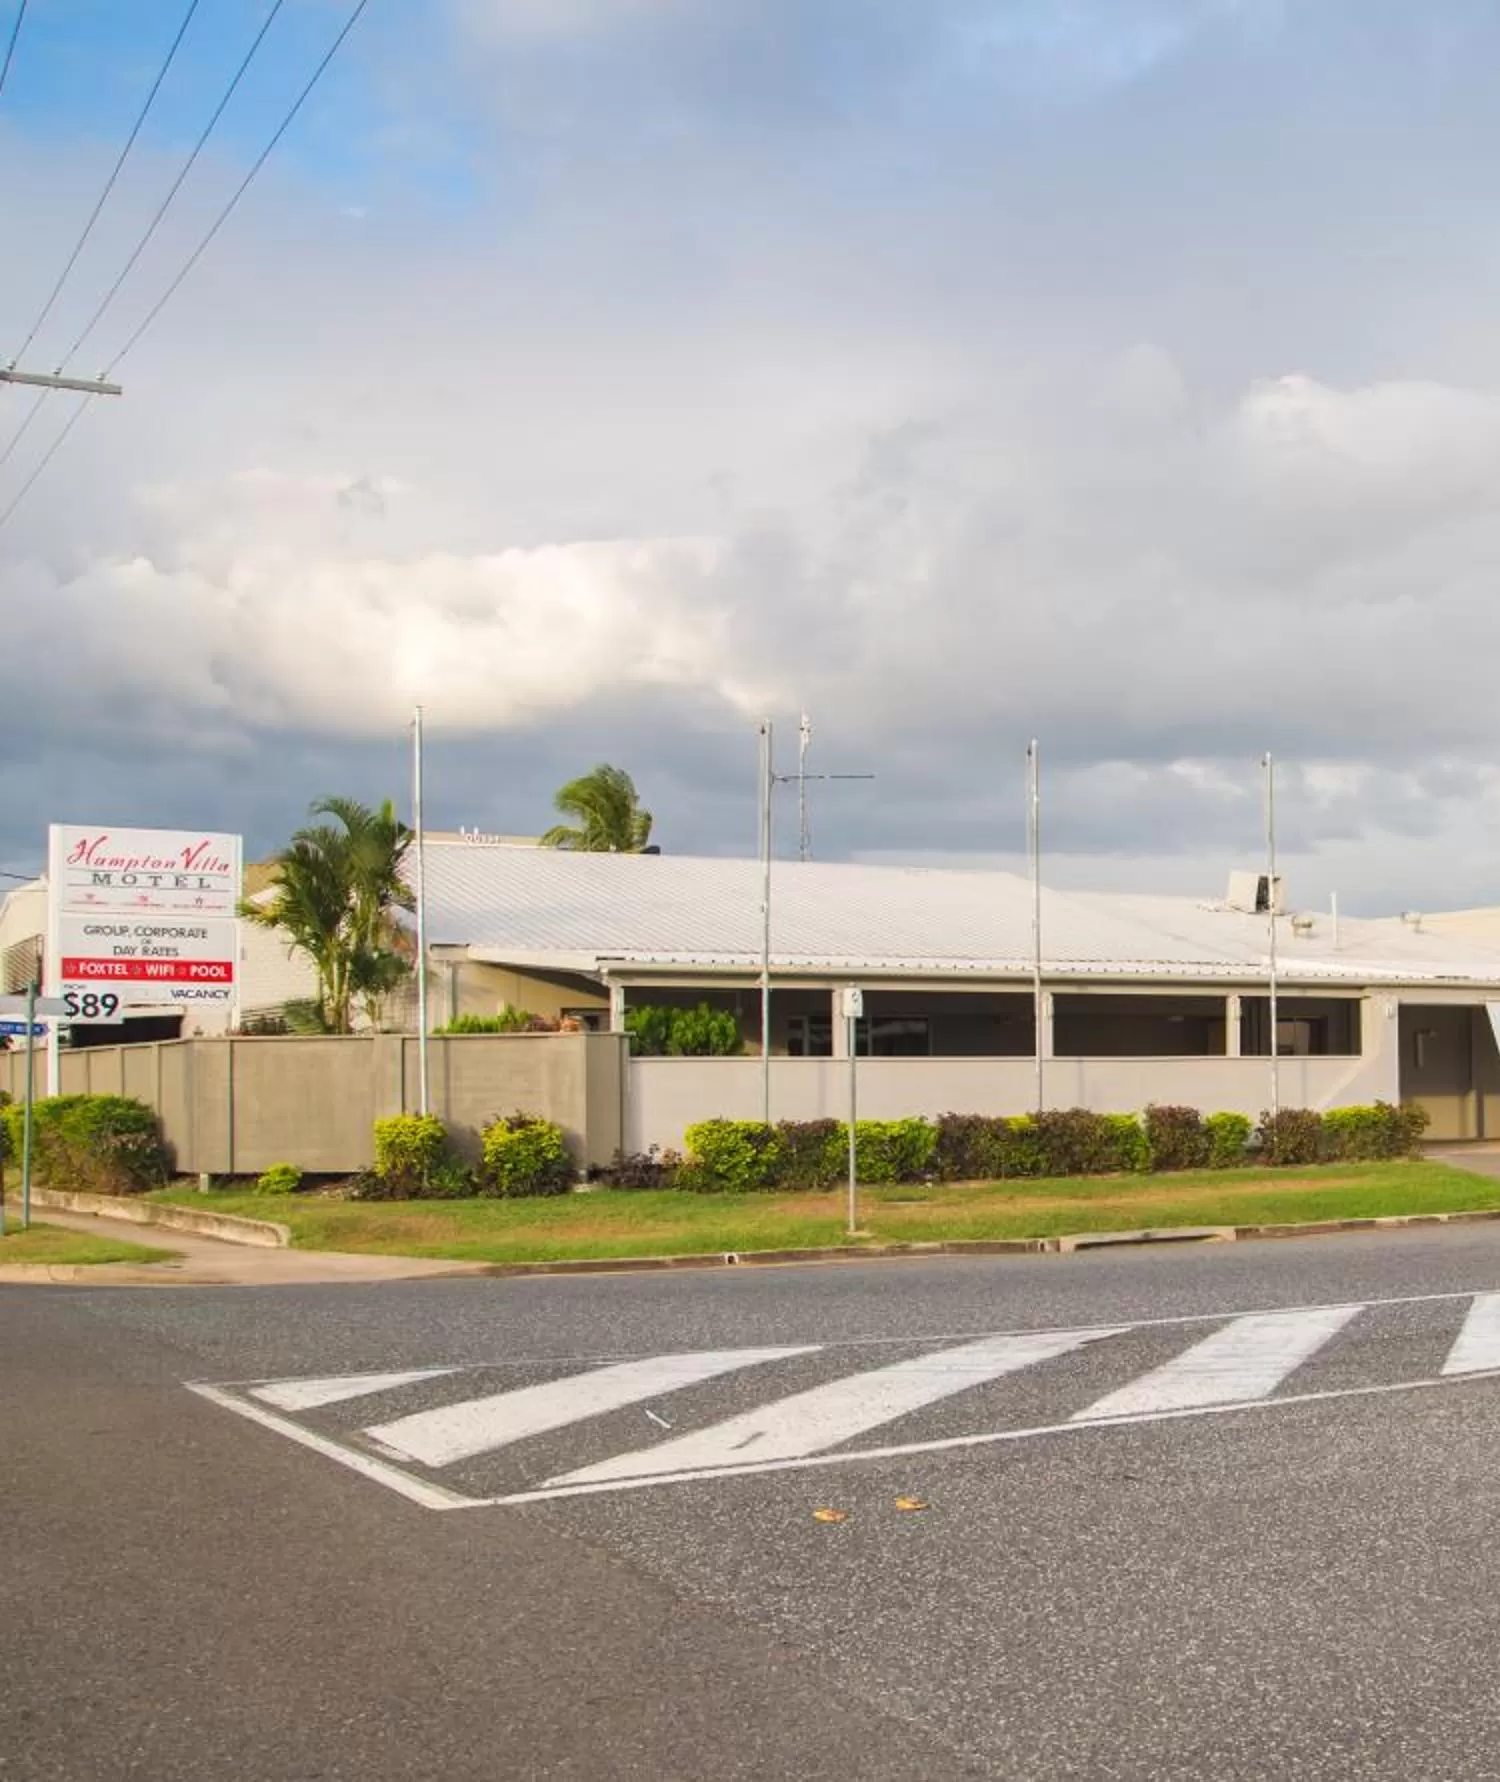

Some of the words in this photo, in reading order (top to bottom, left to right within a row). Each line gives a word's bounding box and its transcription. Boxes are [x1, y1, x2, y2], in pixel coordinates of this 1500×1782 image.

[66, 835, 177, 872] Hampton
[181, 840, 230, 872] Villa
[92, 873, 211, 889] MOTEL
[134, 926, 208, 939] CORPORATE
[113, 945, 137, 956] DAY
[142, 946, 180, 957] RATES
[79, 963, 129, 976] FOXTEL
[145, 965, 175, 976] WIFI
[190, 966, 227, 977] POOL
[171, 989, 231, 1000] VACANCY
[63, 991, 120, 1019] $89
